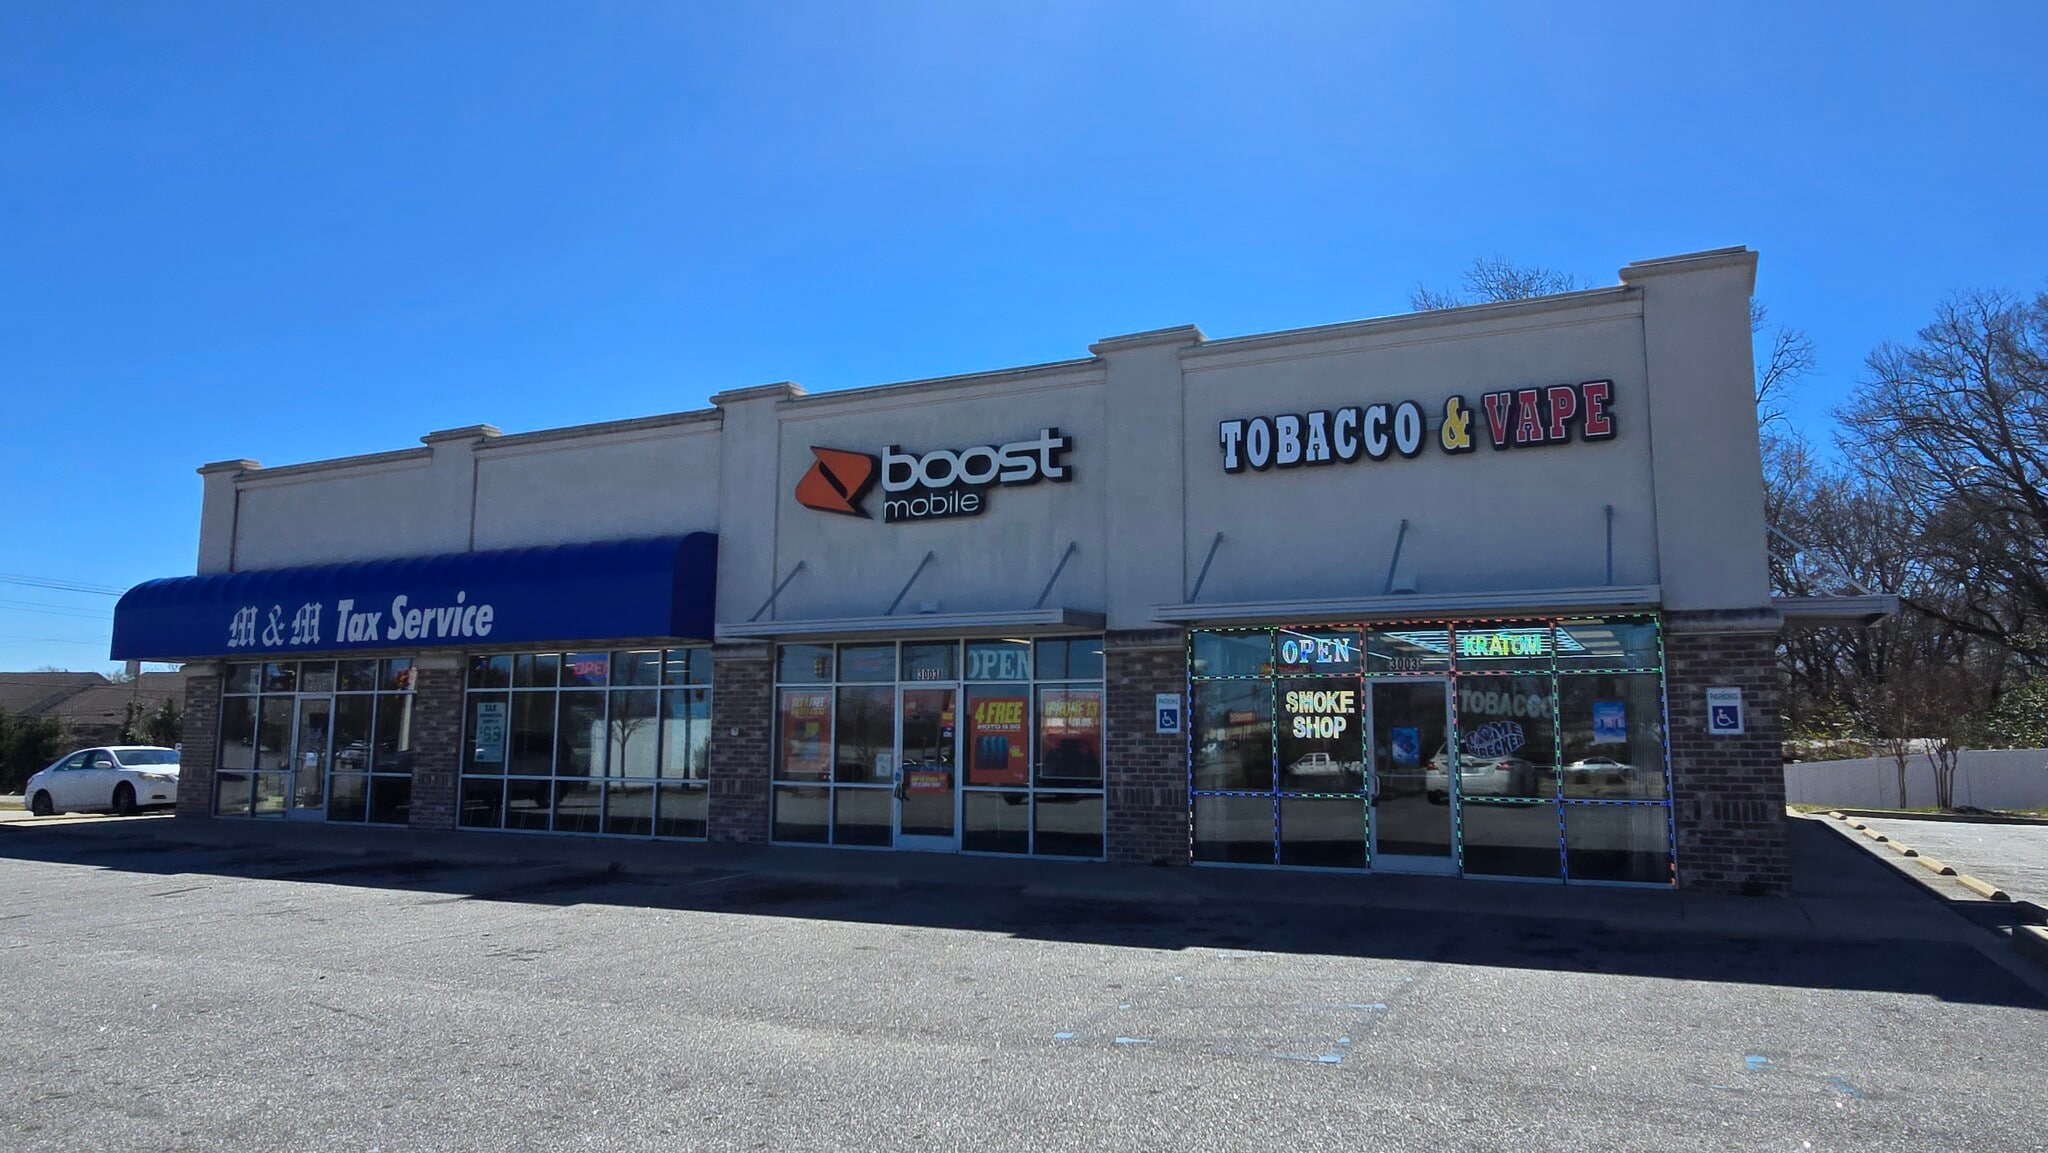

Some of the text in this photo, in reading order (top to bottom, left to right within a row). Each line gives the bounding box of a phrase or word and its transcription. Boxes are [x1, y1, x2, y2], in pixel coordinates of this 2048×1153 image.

[1220, 380, 1613, 471] TOBACCO & VAPE
[881, 428, 1064, 493] boost
[883, 489, 980, 519] mobile
[261, 604, 286, 647] &
[336, 598, 382, 643] Tax
[387, 590, 494, 640] Service
[1282, 637, 1350, 664] OPEN
[1463, 633, 1542, 656] KRATOM
[975, 703, 986, 724] 4
[987, 702, 1024, 724] FREE
[1285, 690, 1355, 714] SMOKE
[1458, 689, 1554, 718] TOBACCO
[1292, 716, 1347, 739] SHOP
